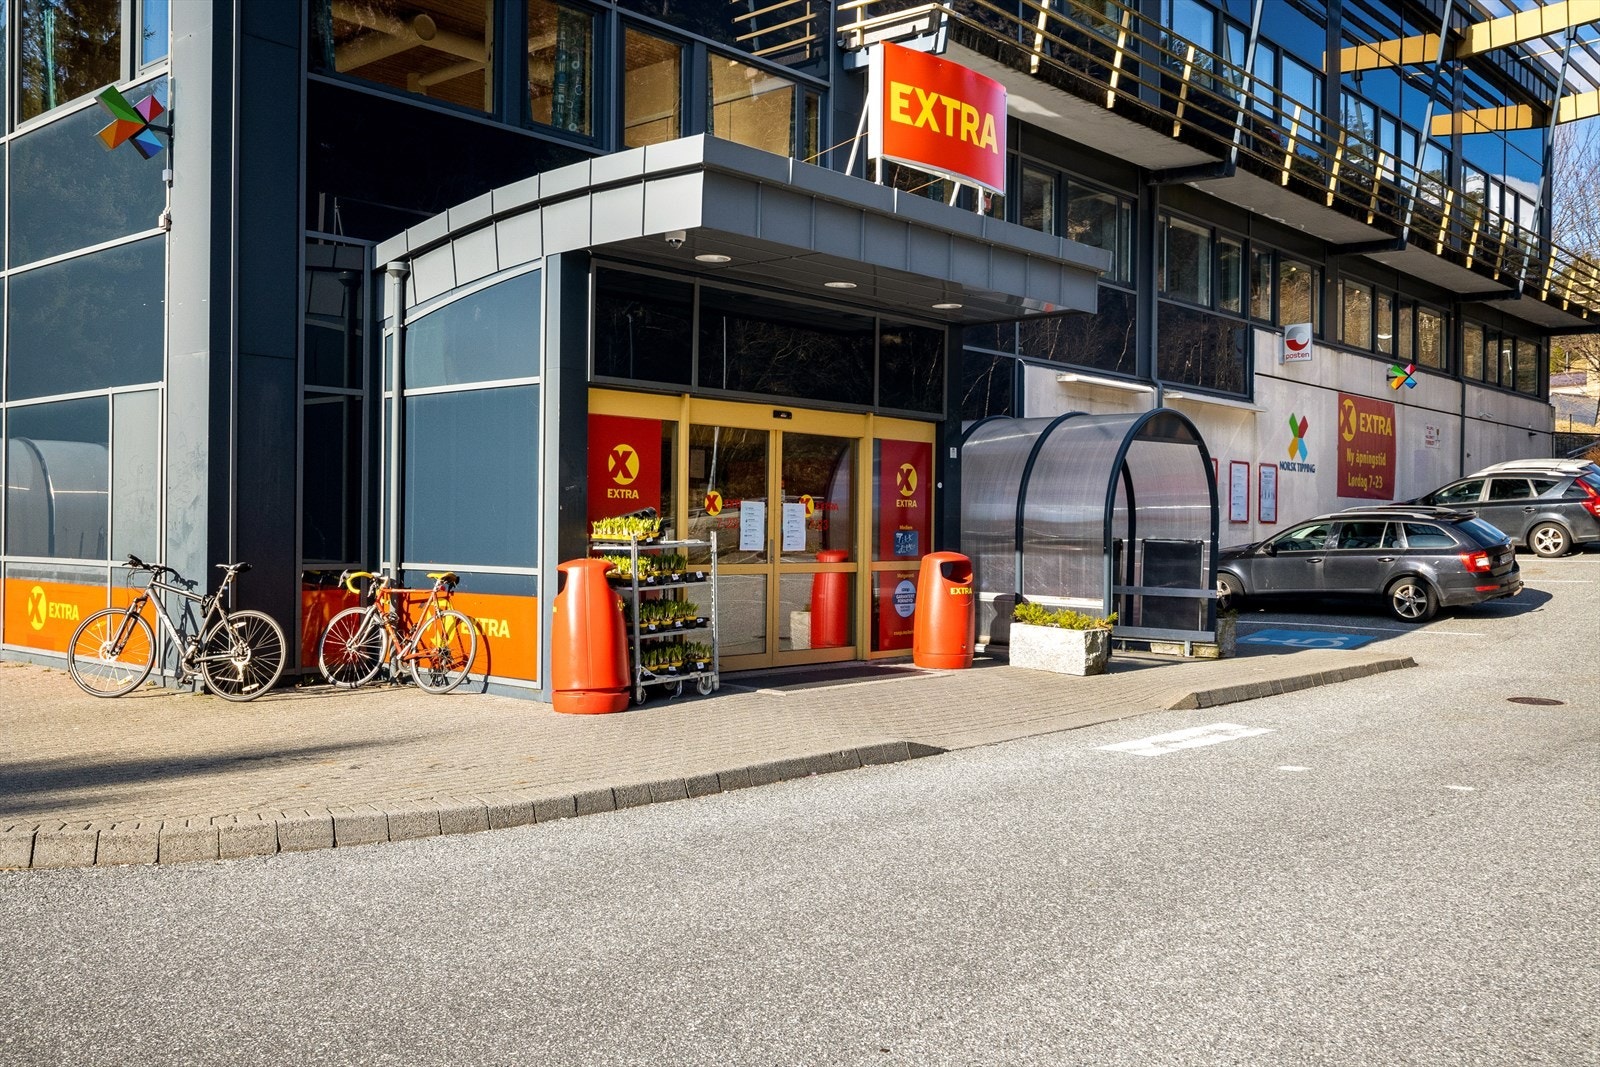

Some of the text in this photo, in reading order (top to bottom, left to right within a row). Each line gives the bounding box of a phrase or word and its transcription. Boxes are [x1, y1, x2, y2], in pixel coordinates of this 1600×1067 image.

[890, 80, 999, 155] EXTRA
[1285, 351, 1310, 360] posten
[1359, 412, 1392, 437] EXTRA
[1346, 447, 1387, 469] Ny åpningstid
[1279, 460, 1316, 474] NORSK TIPPING
[1347, 472, 1368, 492] Lørdag
[607, 488, 640, 500] EXTRA
[896, 499, 918, 508] EXTRA
[950, 587, 973, 595] EXTRA
[48, 601, 80, 622] EXTRA
